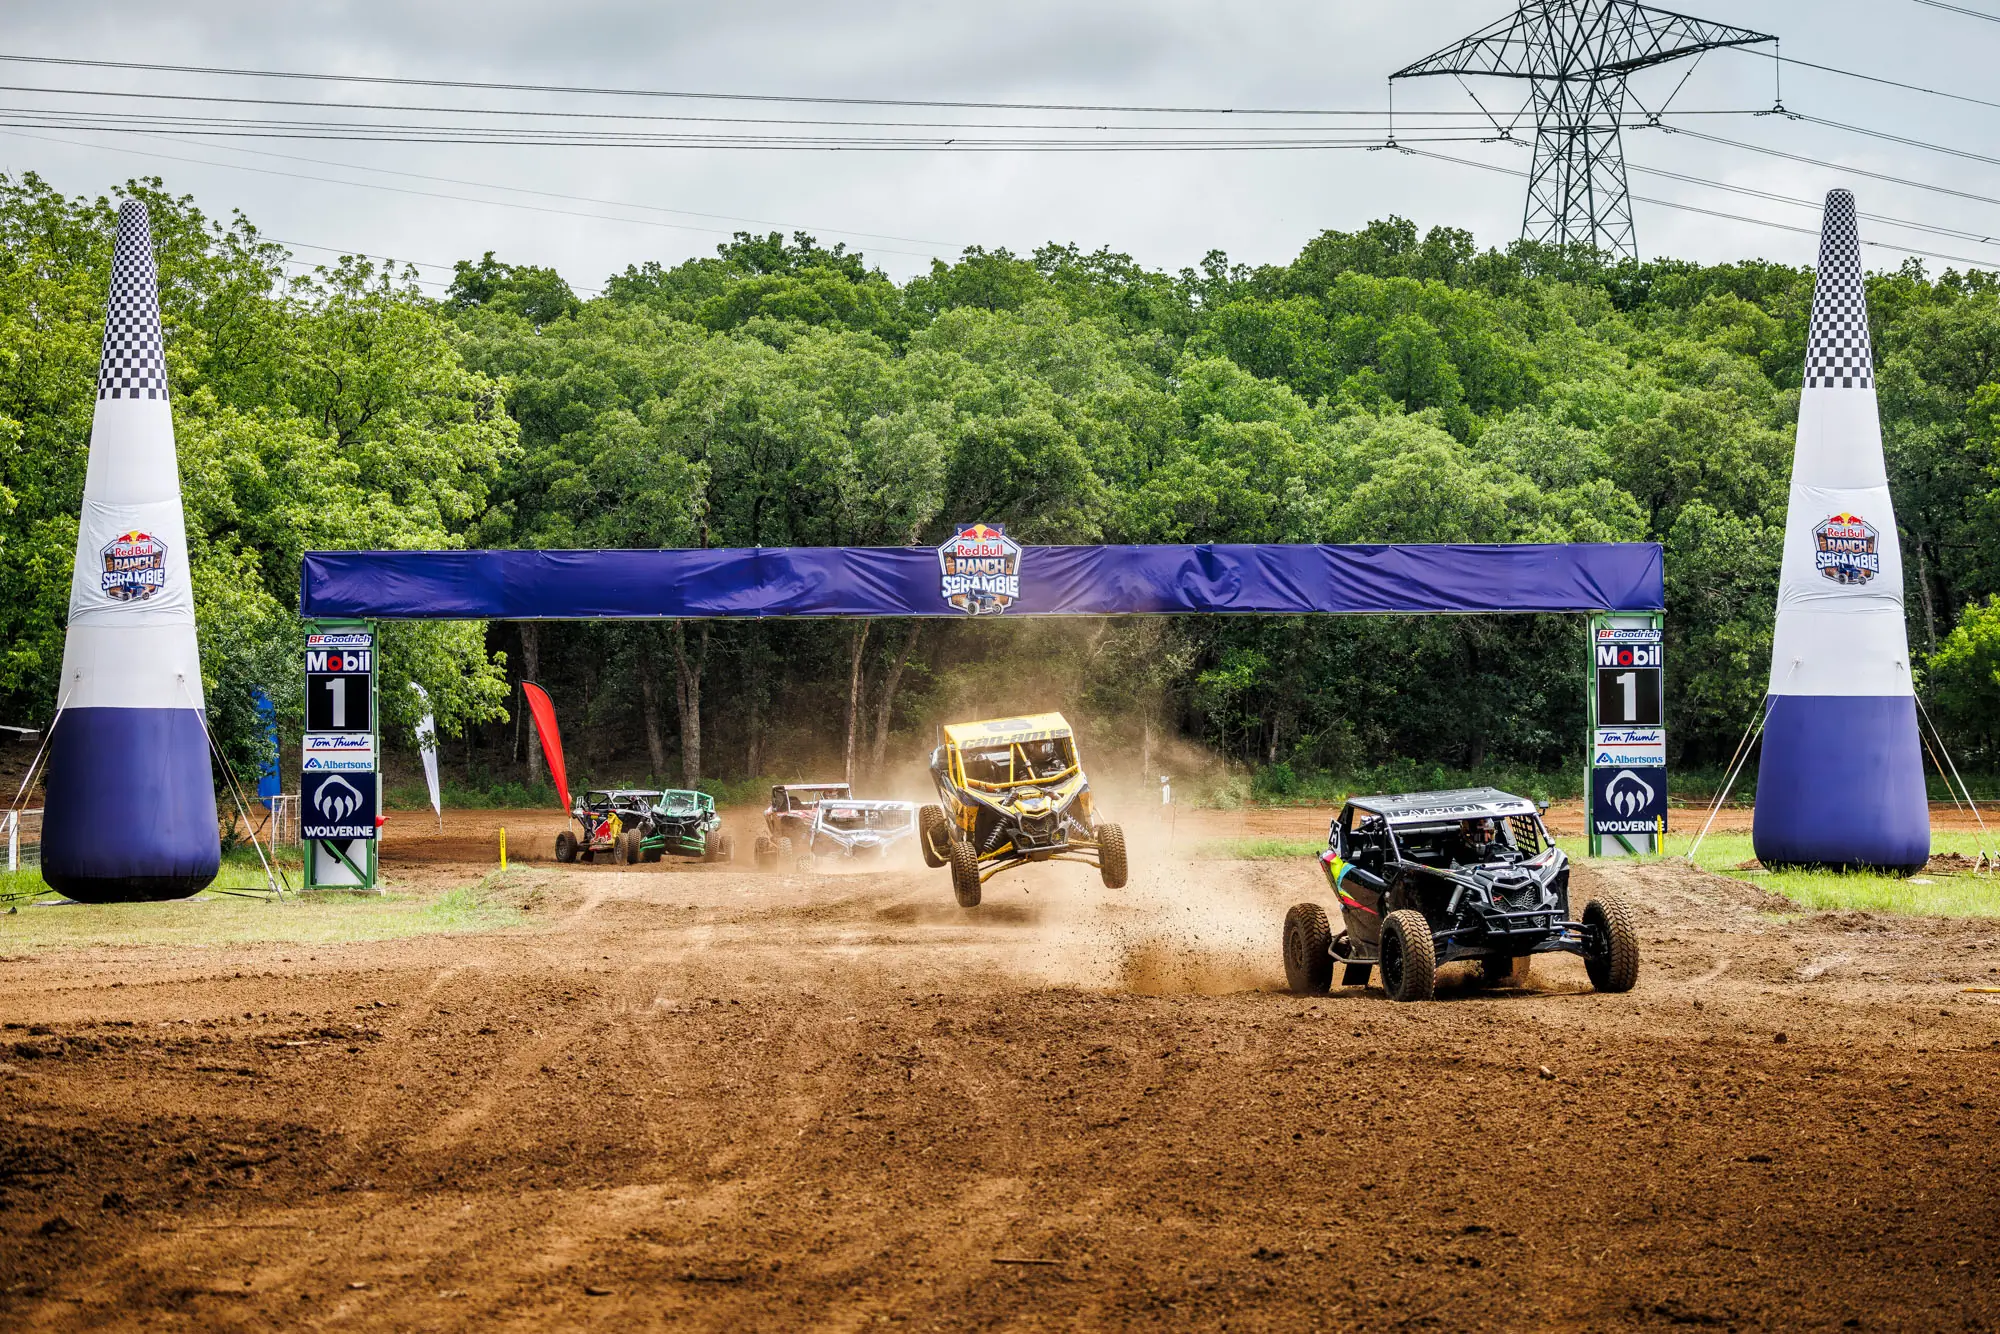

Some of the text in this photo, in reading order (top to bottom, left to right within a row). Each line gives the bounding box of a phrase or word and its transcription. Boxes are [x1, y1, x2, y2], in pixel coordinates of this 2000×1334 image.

[1827, 527, 1865, 538] Red Bull
[115, 544, 153, 557] Red Bull
[956, 544, 1003, 556] Red Bull
[1827, 539, 1867, 553] RANCH
[114, 556, 154, 571] RANCH
[955, 558, 1006, 575] RANCH
[1816, 551, 1879, 573] SCRAMBLE
[102, 568, 164, 590] SCRAMBLE
[941, 575, 1020, 599] SCRAMBLE
[309, 635, 371, 644] BFGoodrich
[1599, 629, 1661, 638] BFGoodrich
[307, 651, 370, 671] Mobil
[1597, 645, 1660, 666] Mobil
[325, 677, 346, 727] 1
[1616, 672, 1637, 722] 1
[308, 735, 369, 748] Tom Thumb
[960, 729, 1046, 748] can-am
[1599, 730, 1660, 743] Tom Thumb
[322, 760, 372, 769] Albertsons
[1614, 755, 1664, 764] Albertsons
[303, 825, 374, 837] WOLVERINE
